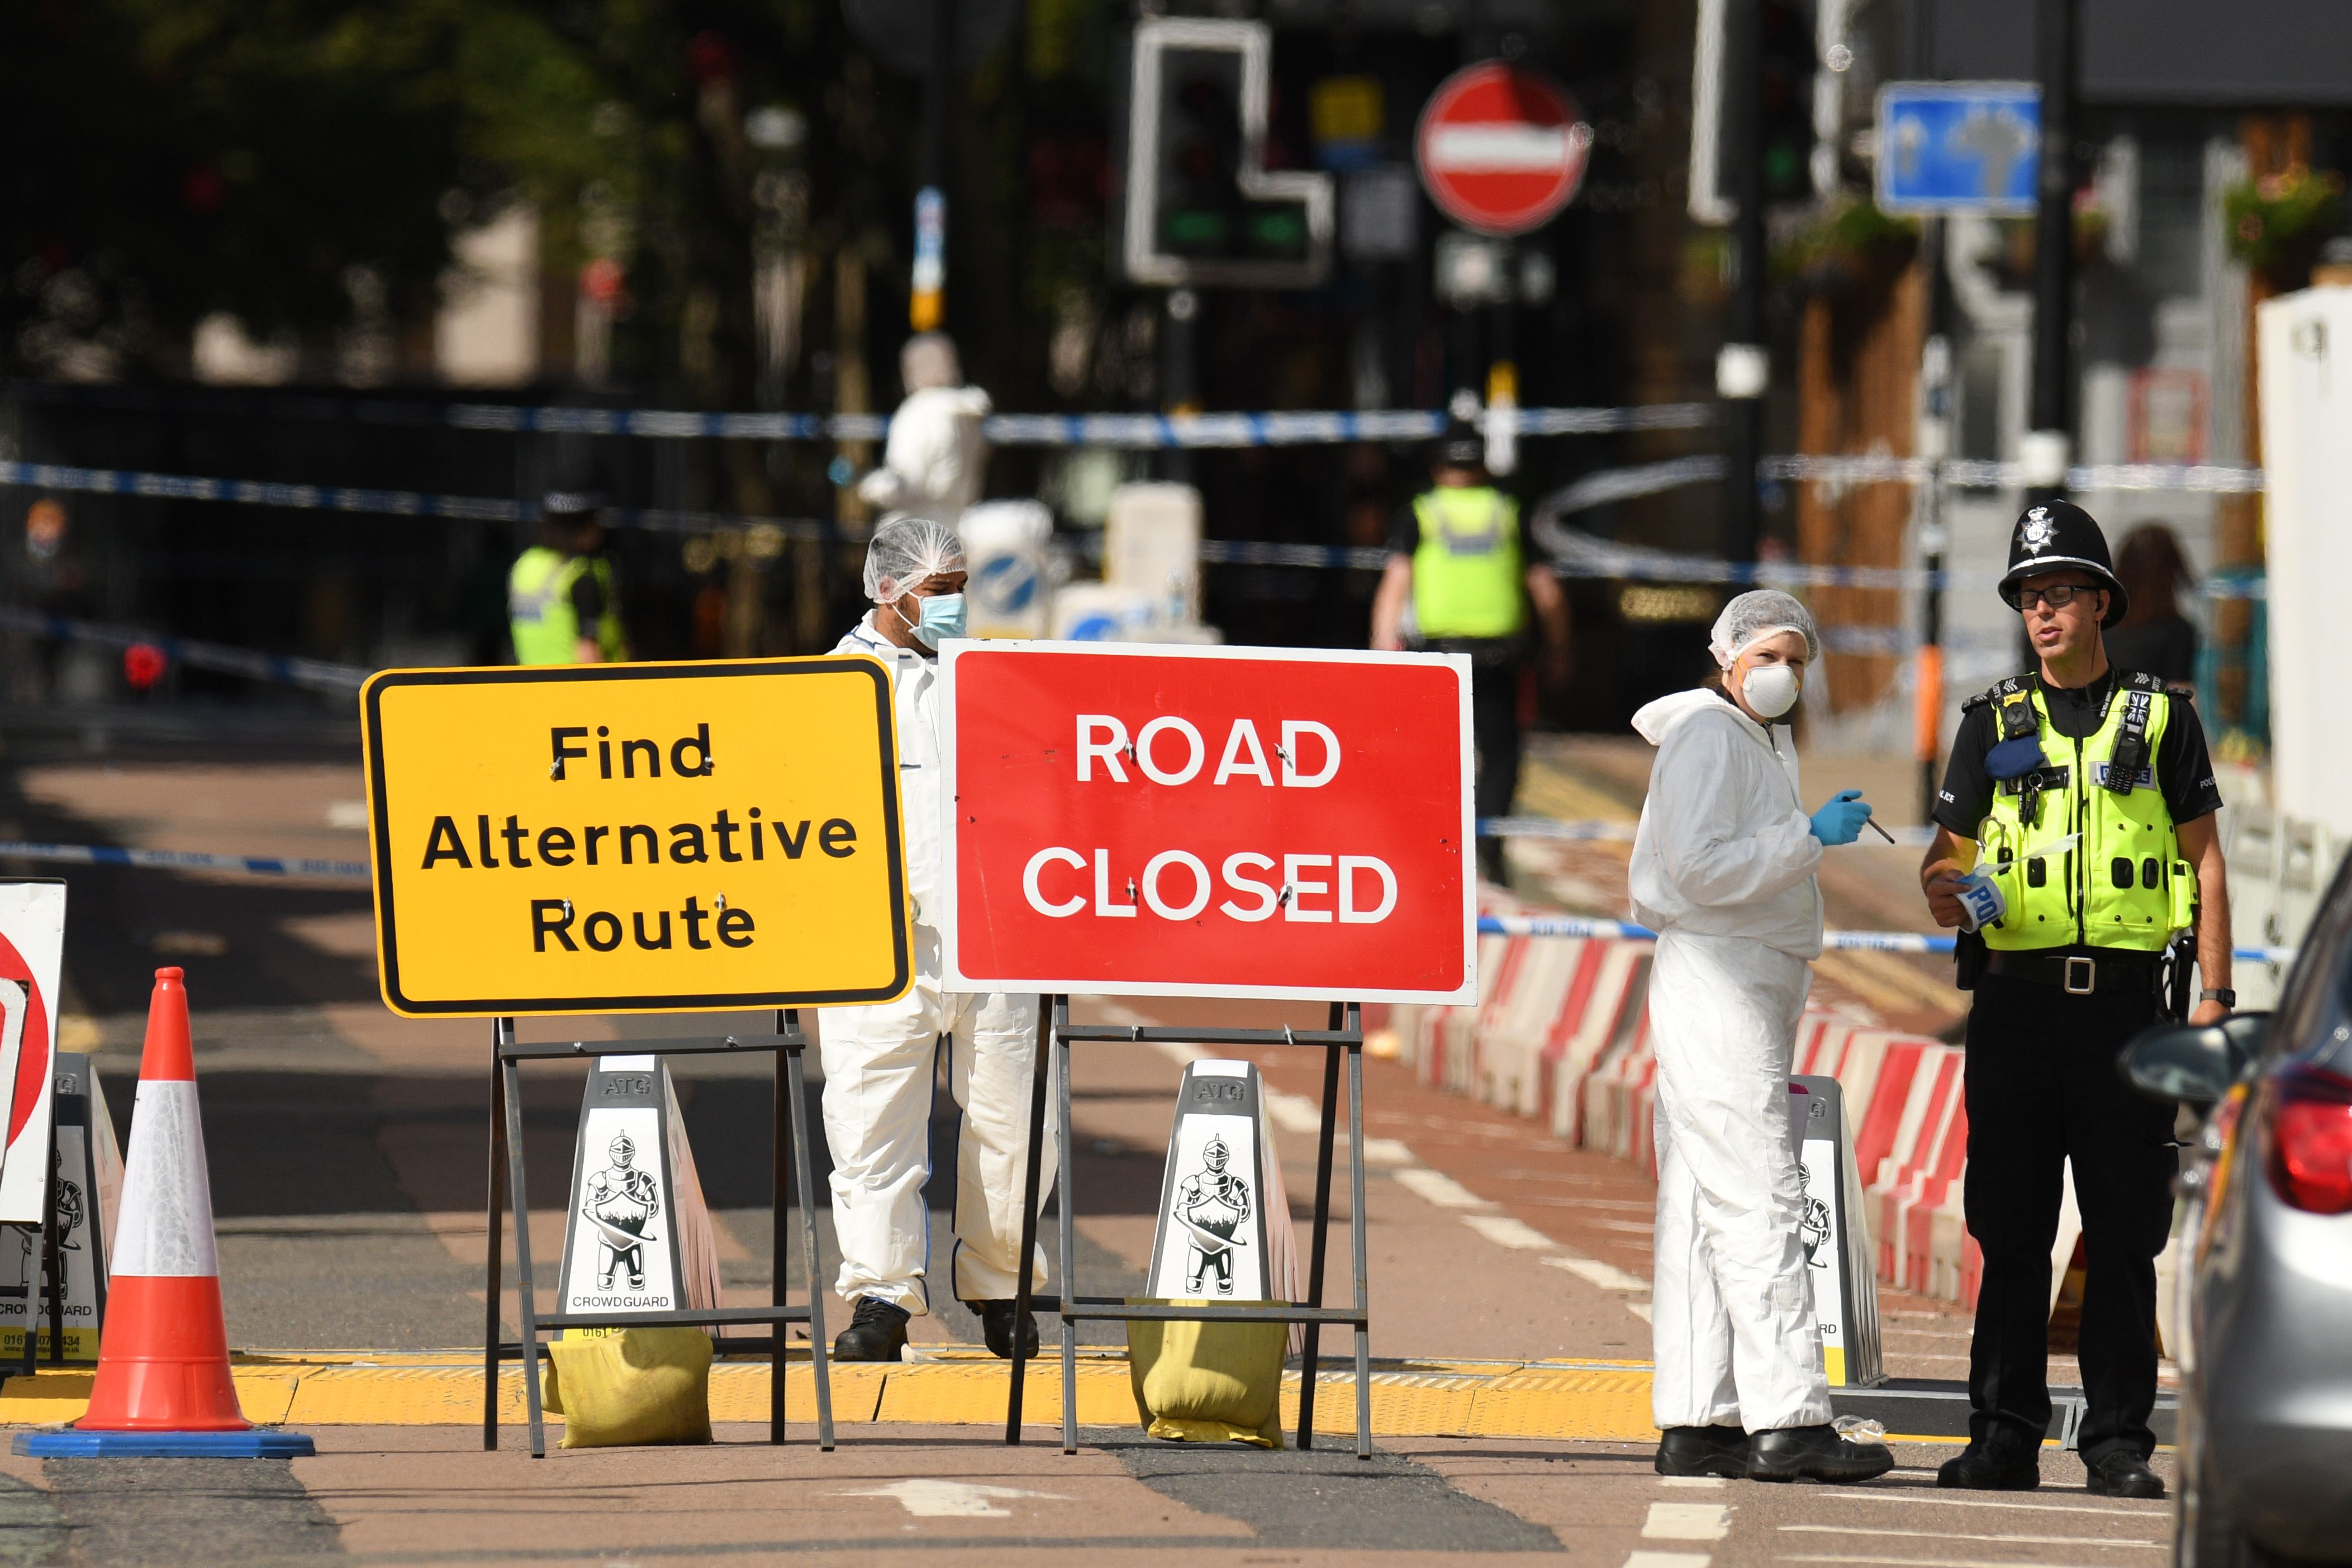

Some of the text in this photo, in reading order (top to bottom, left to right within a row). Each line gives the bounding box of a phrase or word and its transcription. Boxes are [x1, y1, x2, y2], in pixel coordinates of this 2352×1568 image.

[550, 723, 712, 781] Find
[1076, 715, 1341, 787] ROAD
[421, 806, 857, 869] Alternative
[1023, 847, 1398, 924] CLOSED
[530, 895, 755, 952] Route
[602, 1078, 650, 1095] ATG
[1195, 1084, 1243, 1100] ATG
[573, 1296, 669, 1307] CROWDGUARD
[4, 1334, 26, 1345] 016
